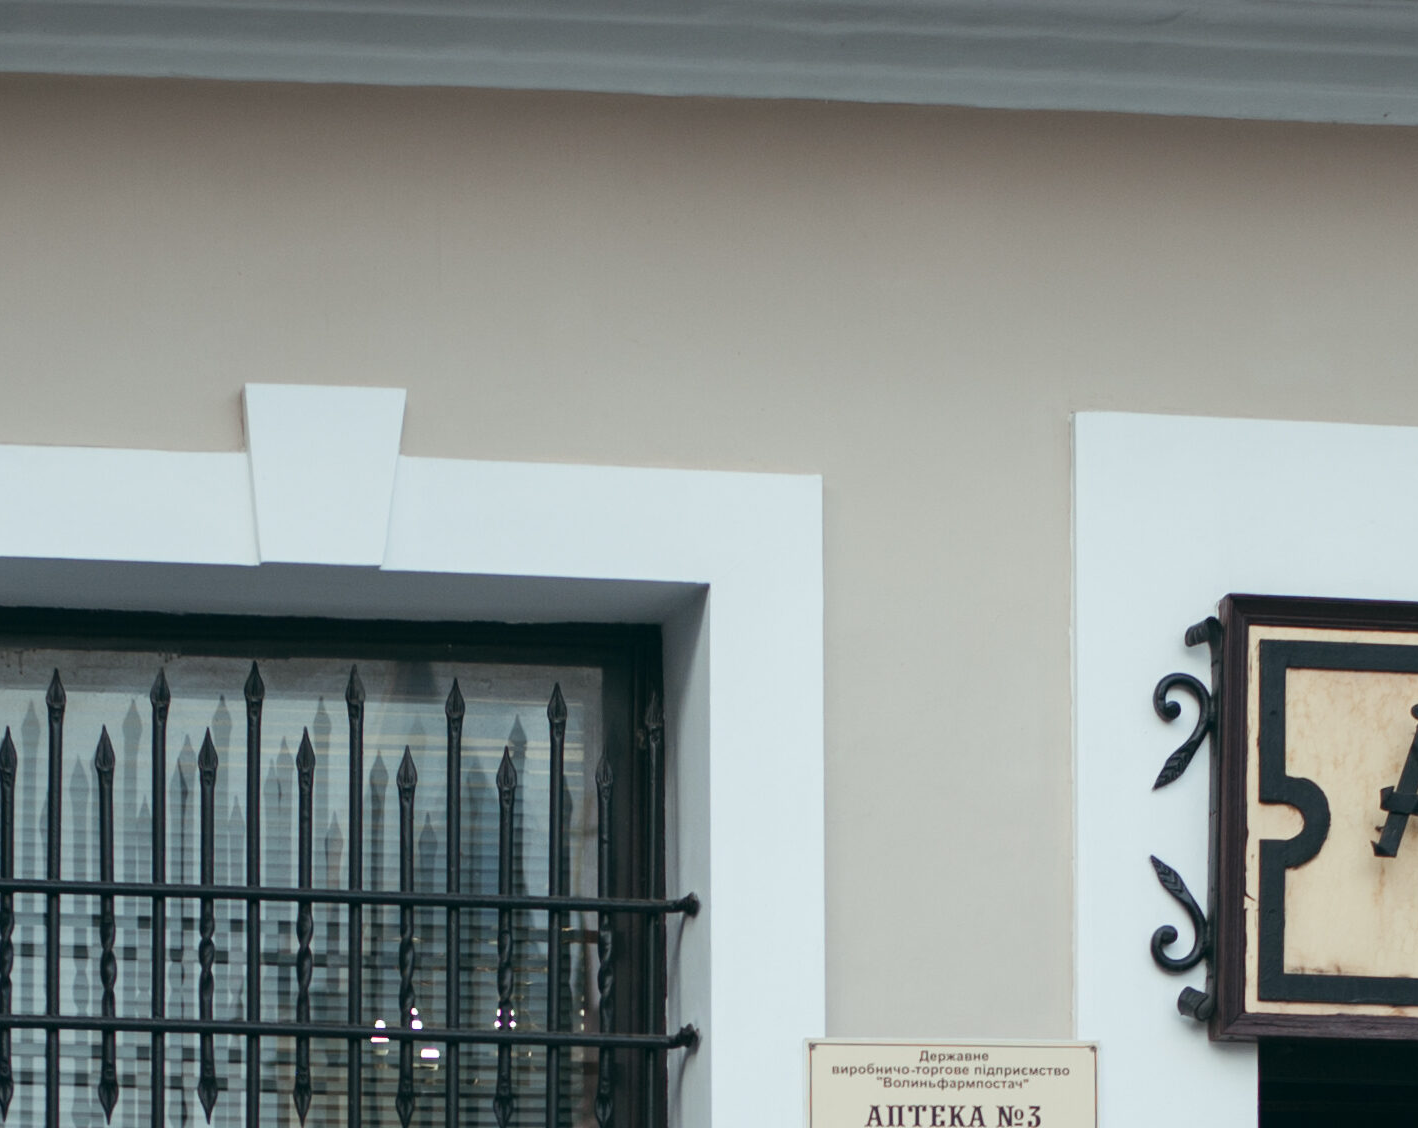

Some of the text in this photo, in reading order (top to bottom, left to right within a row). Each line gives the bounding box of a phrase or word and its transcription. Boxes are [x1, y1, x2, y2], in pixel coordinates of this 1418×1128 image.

[919, 1050, 990, 1063] Державне
[831, 1063, 1071, 1078] виробничо-торгове підприємство
[864, 1104, 1042, 1128] АПТЕКА №3
